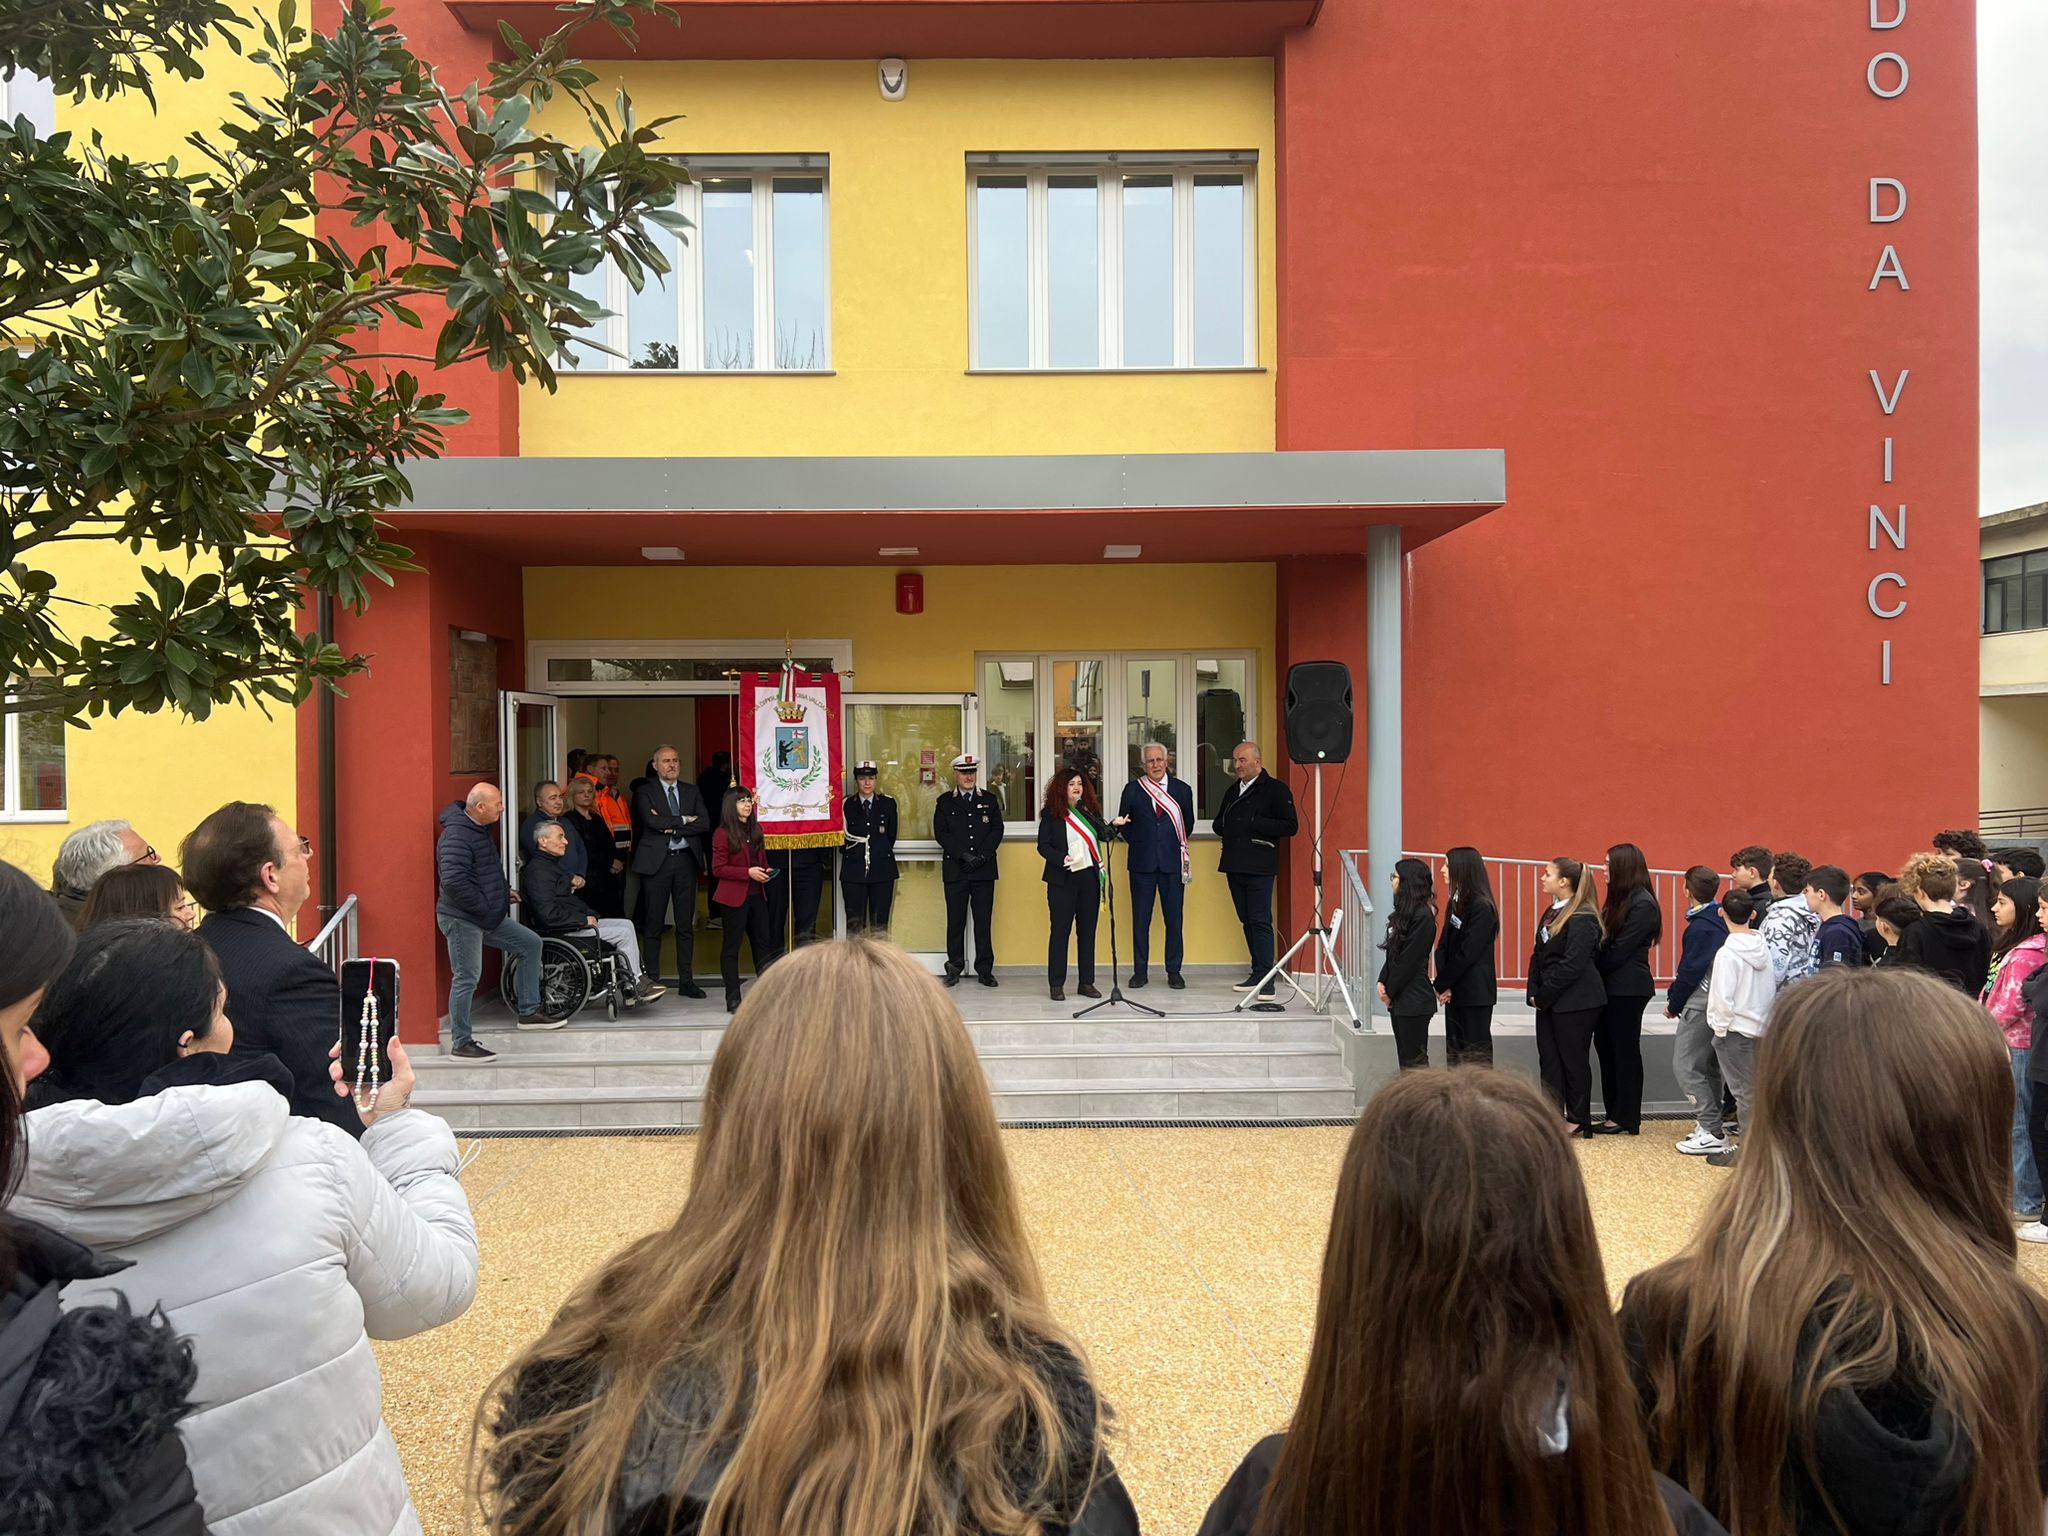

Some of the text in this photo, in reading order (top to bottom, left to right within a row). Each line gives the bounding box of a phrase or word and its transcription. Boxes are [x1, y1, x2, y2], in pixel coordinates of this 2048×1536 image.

[1867, 0, 1910, 685] DO DA VINCI
